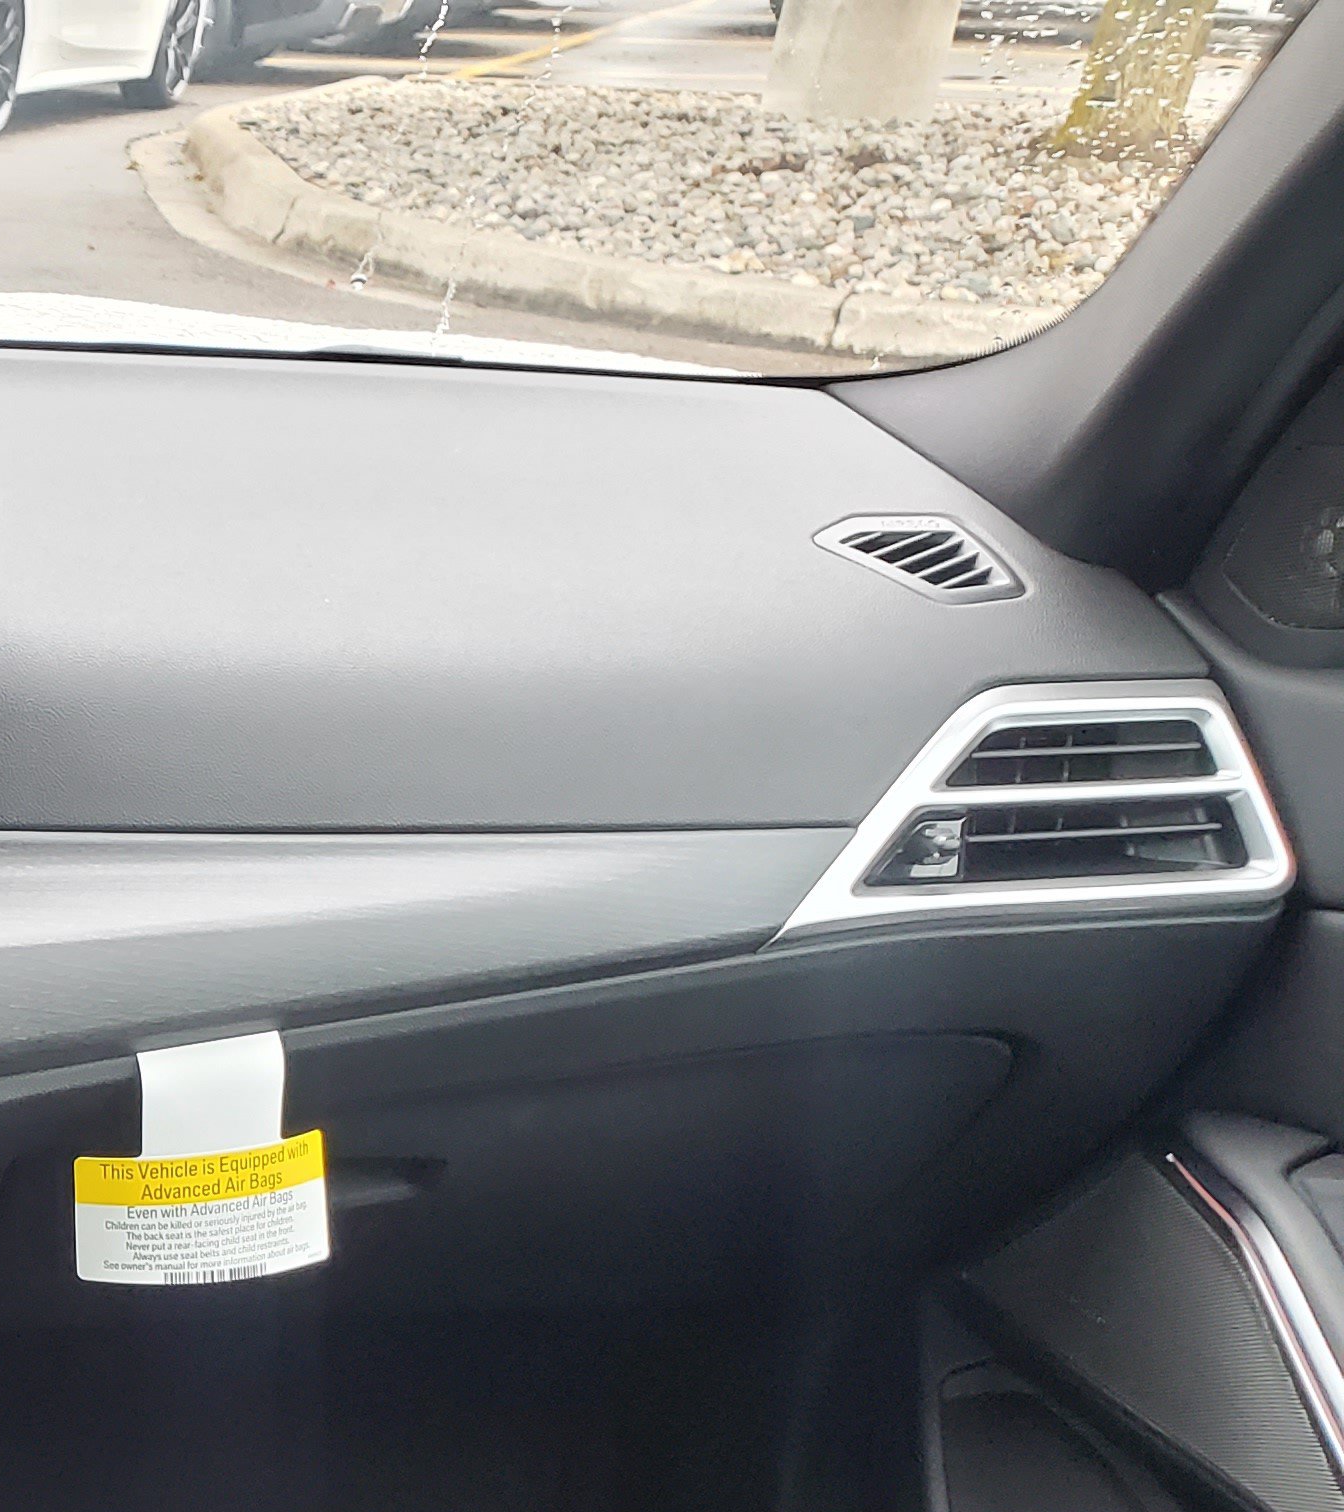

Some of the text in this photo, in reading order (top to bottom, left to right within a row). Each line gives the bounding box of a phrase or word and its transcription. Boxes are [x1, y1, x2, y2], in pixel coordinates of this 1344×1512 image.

[100, 1140, 309, 1180] This Vehicle is Equipped with
[141, 1171, 283, 1200] Advanced Air Bags
[127, 1190, 294, 1219] Even with Advanced Air Bags
[105, 1220, 139, 1230] Children
[141, 1222, 156, 1230] can
[158, 1220, 168, 1230] be
[170, 1219, 192, 1229] killed
[204, 1213, 240, 1228] seriously
[241, 1209, 266, 1224] injured
[267, 1206, 275, 1219] by
[276, 1205, 287, 1215] the
[126, 1231, 142, 1240] The
[143, 1231, 164, 1240] back
[165, 1231, 183, 1240] seat
[194, 1229, 207, 1238] the
[209, 1224, 233, 1236] safest
[234, 1222, 255, 1235] place
[126, 1242, 150, 1251] Never
[152, 1242, 165, 1252] put
[221, 1234, 240, 1246] child
[241, 1232, 257, 1243] seat
[266, 1229, 277, 1238] the
[103, 1260, 119, 1269] See
[121, 1262, 153, 1271] owner's
[155, 1260, 185, 1270] manual
[187, 1260, 198, 1269] for
[200, 1259, 222, 1268] more
[223, 1252, 266, 1266] information
[267, 1248, 286, 1260] about
[132, 1252, 162, 1262] Always
[163, 1253, 178, 1261] use
[180, 1251, 198, 1260] seat
[200, 1248, 220, 1258] belts
[221, 1246, 236, 1257] and
[237, 1243, 256, 1254] child
